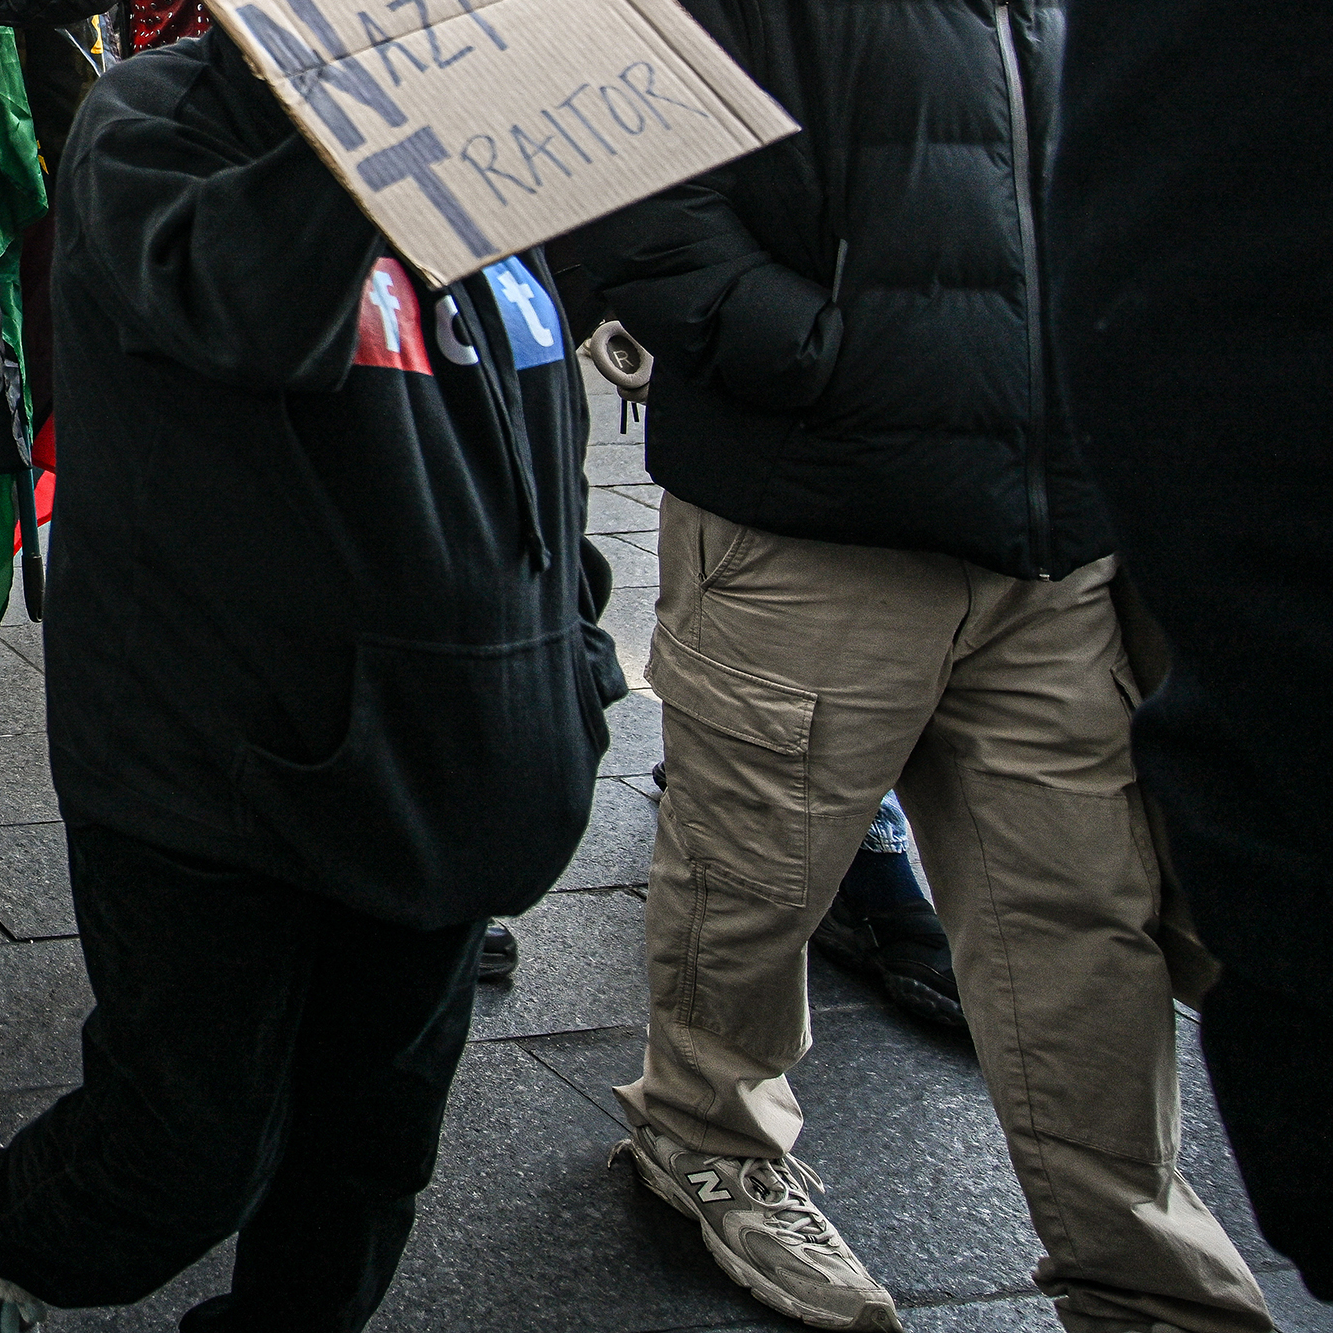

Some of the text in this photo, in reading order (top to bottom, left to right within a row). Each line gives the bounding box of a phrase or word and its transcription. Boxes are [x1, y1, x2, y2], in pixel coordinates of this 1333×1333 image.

[355, 60, 709, 257] TRAITOR
[496, 270, 554, 347] t
[613, 350, 634, 368] R
